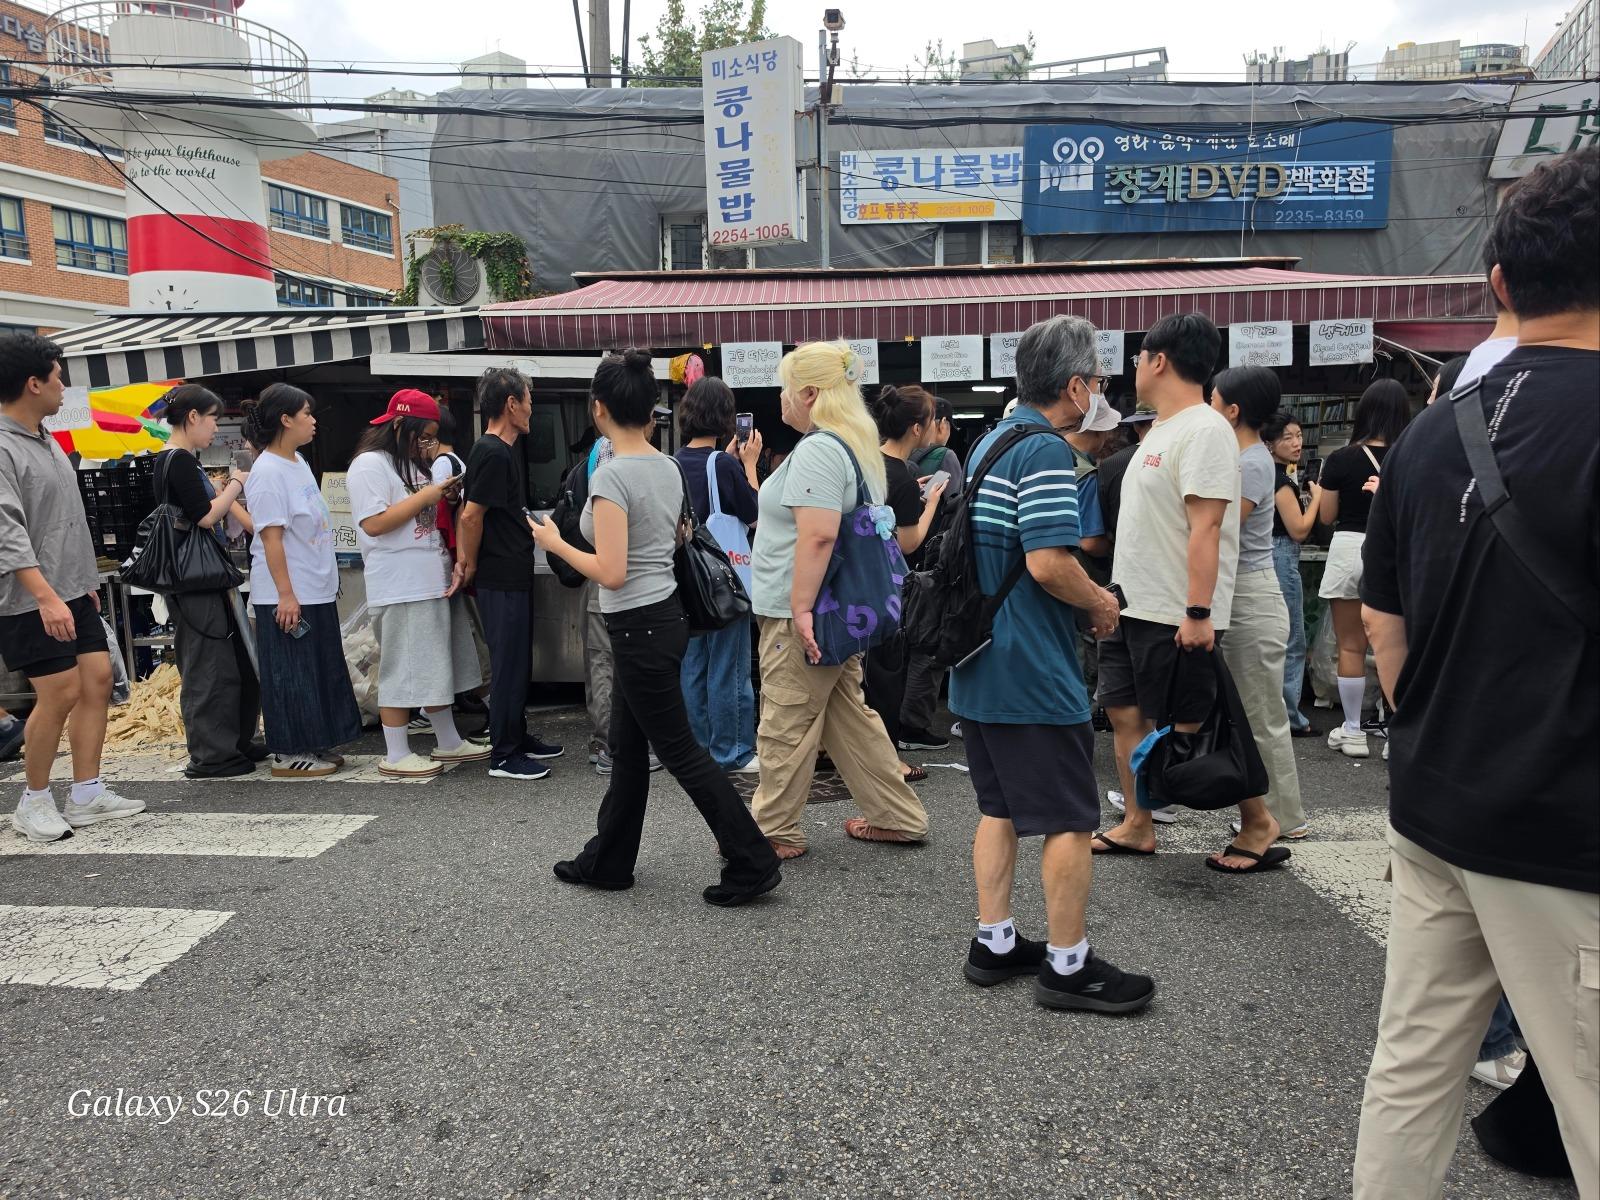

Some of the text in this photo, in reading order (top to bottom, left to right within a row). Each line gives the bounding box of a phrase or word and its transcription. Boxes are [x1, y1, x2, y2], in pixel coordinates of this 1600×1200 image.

[712, 50, 778, 80] 미소식당
[144, 147, 173, 160] your
[177, 145, 241, 167] lighthouse
[713, 85, 755, 223] 콩나물밥
[141, 167, 150, 177] to
[153, 164, 172, 176] the
[175, 167, 217, 180] world
[872, 152, 1022, 192] 콩나물밥
[841, 154, 858, 219] 미소식당
[884, 201, 919, 220] 동동주
[1275, 209, 1364, 224] 2235-8359
[712, 223, 790, 245] 2254-1005
[1241, 325, 1278, 340] 막걸리
[1318, 323, 1366, 341] 냉커피
[396, 403, 411, 412] KIA
